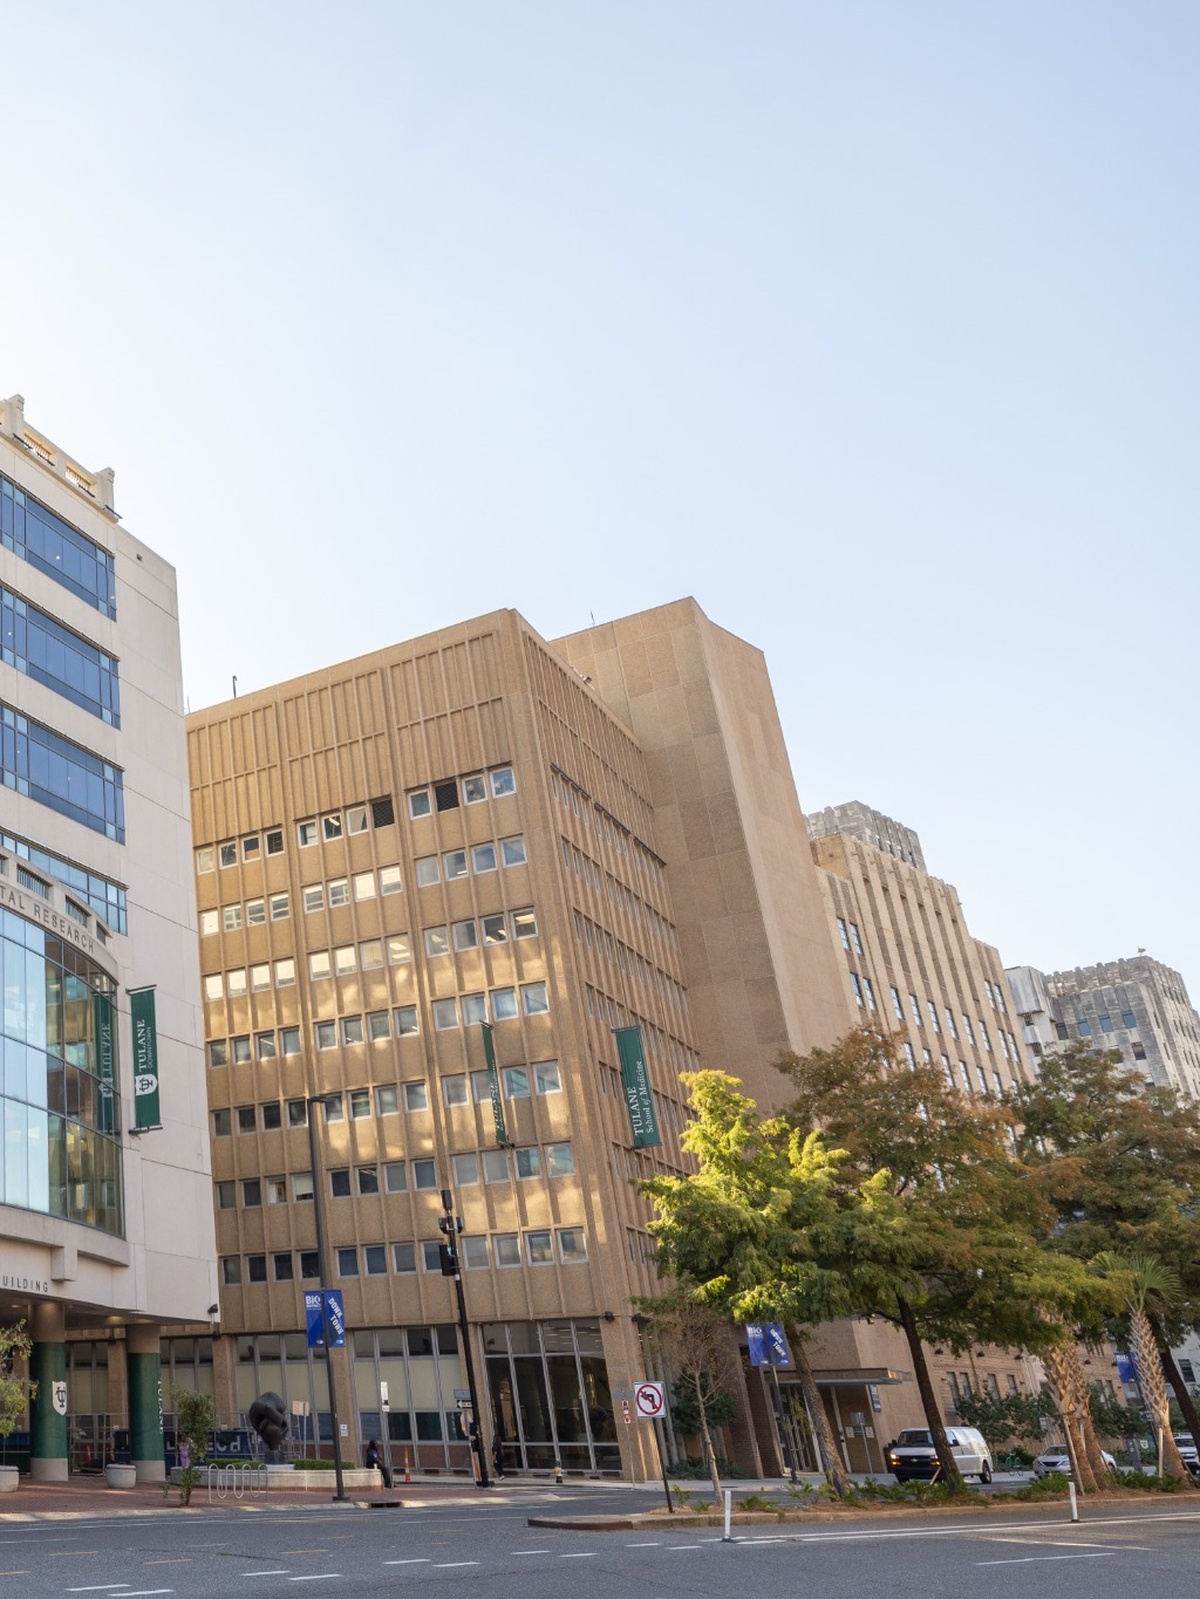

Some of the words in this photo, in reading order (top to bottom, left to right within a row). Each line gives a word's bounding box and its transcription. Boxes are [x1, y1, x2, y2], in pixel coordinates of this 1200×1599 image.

[34, 904, 94, 952] RESEARCH
[138, 1019, 147, 1072] TULANE
[636, 1060, 648, 1095] Medicine
[626, 1086, 644, 1136] TULANE
[641, 1096, 650, 1106] of
[644, 1107, 654, 1134] School
[328, 1297, 343, 1318] DOWN
[330, 1314, 345, 1335] TOWN
